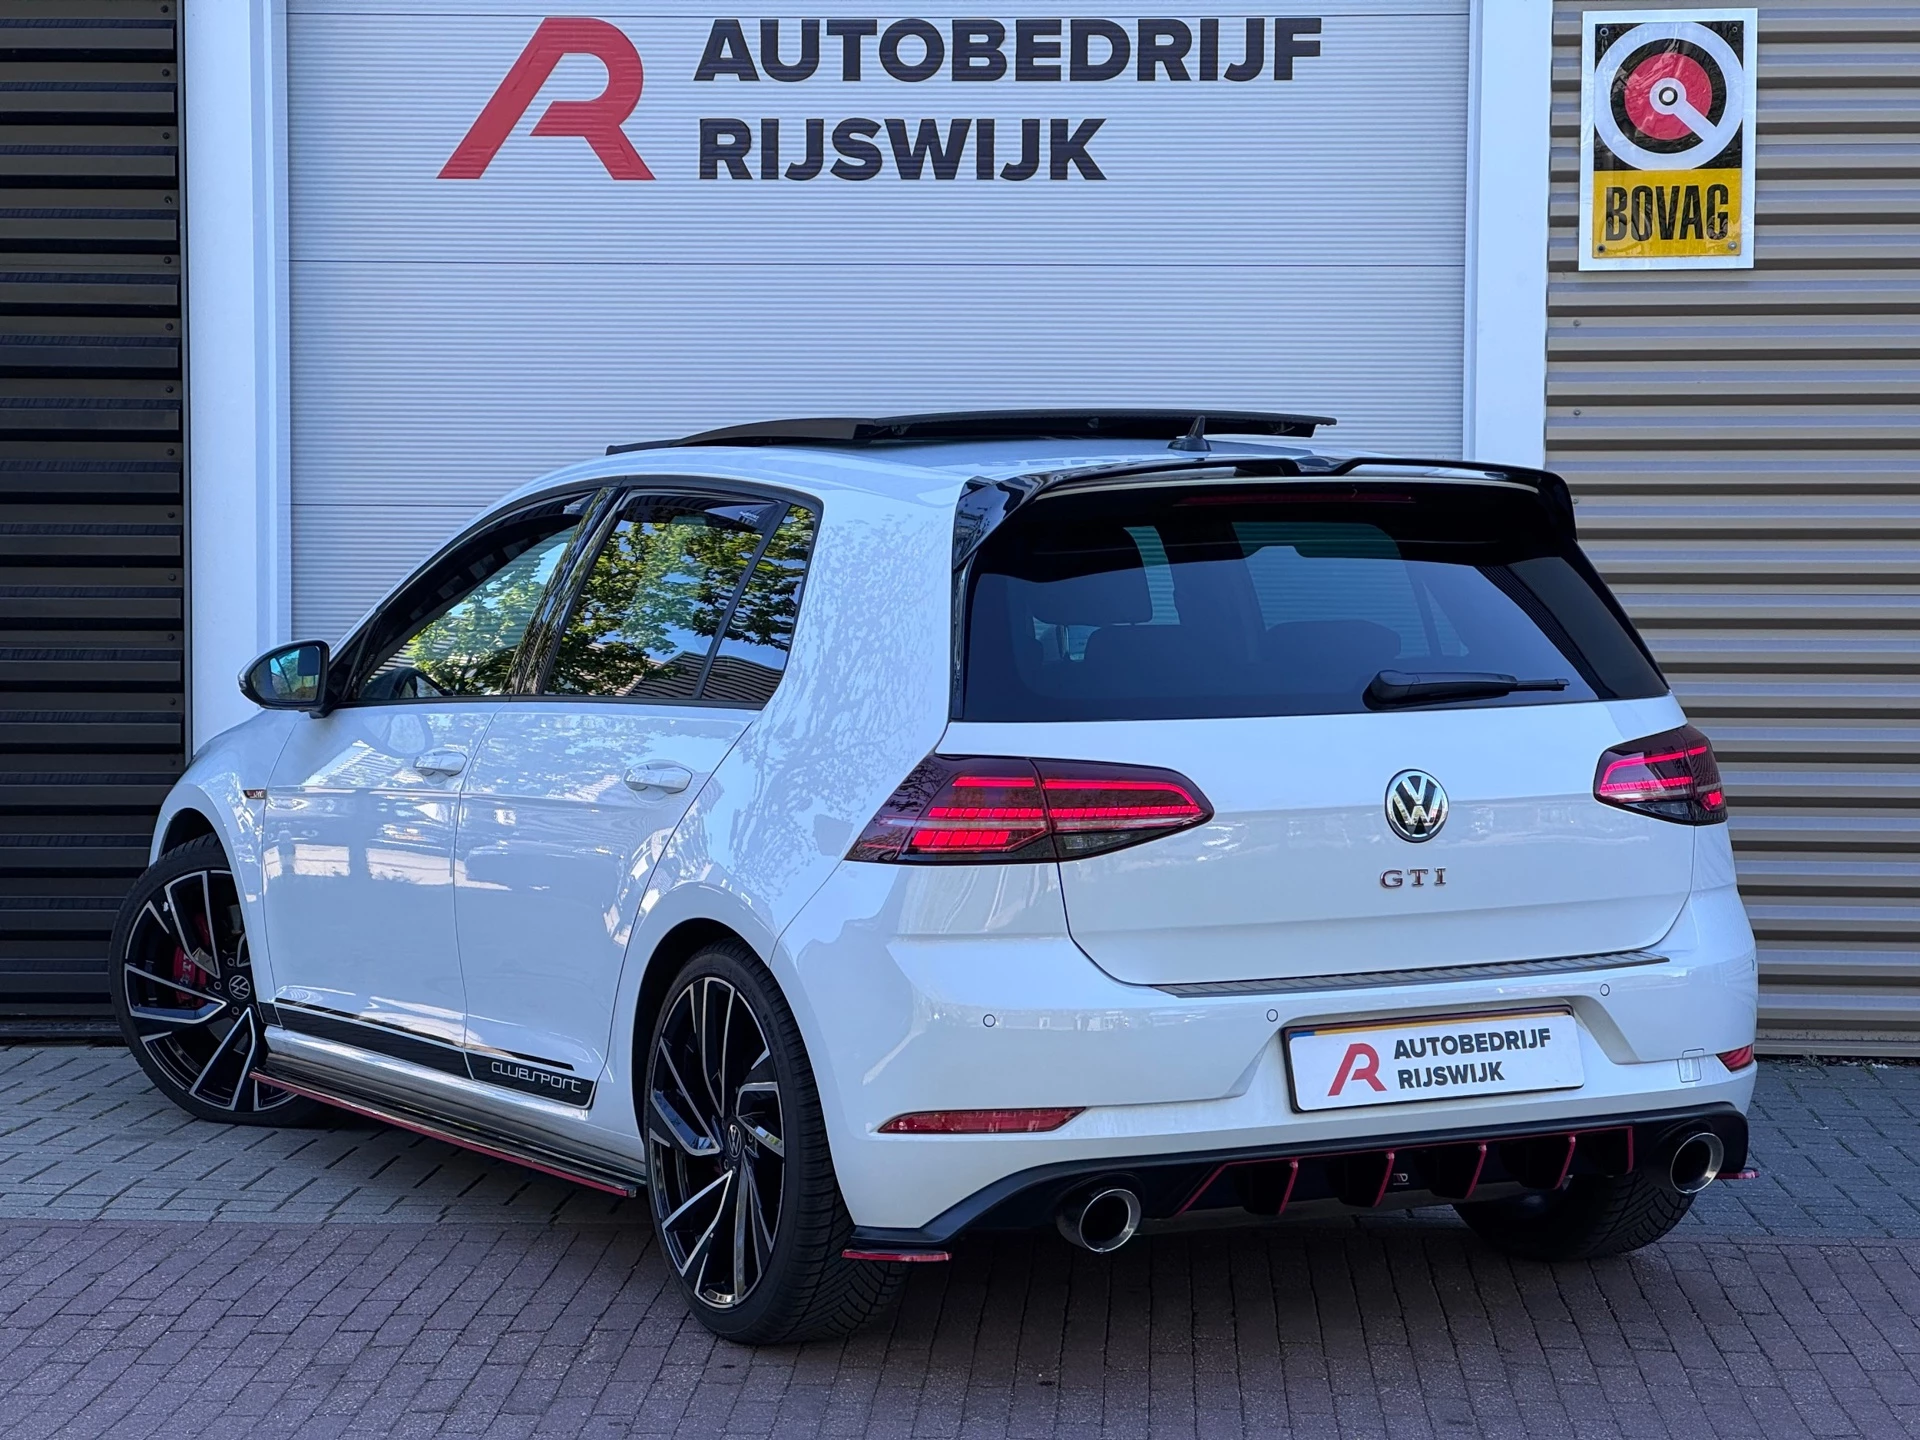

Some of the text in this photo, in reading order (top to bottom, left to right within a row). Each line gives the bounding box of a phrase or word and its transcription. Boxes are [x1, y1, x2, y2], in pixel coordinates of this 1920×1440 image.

[692, 17, 1323, 82] AUTOBEDRIJF
[699, 117, 1107, 181] RIJSWIJK
[1605, 183, 1729, 242] BOVAG
[1380, 866, 1447, 889] GTI
[1393, 1027, 1552, 1060] AUTOBEDRIJF
[1397, 1061, 1506, 1090] RIJSWIJK
